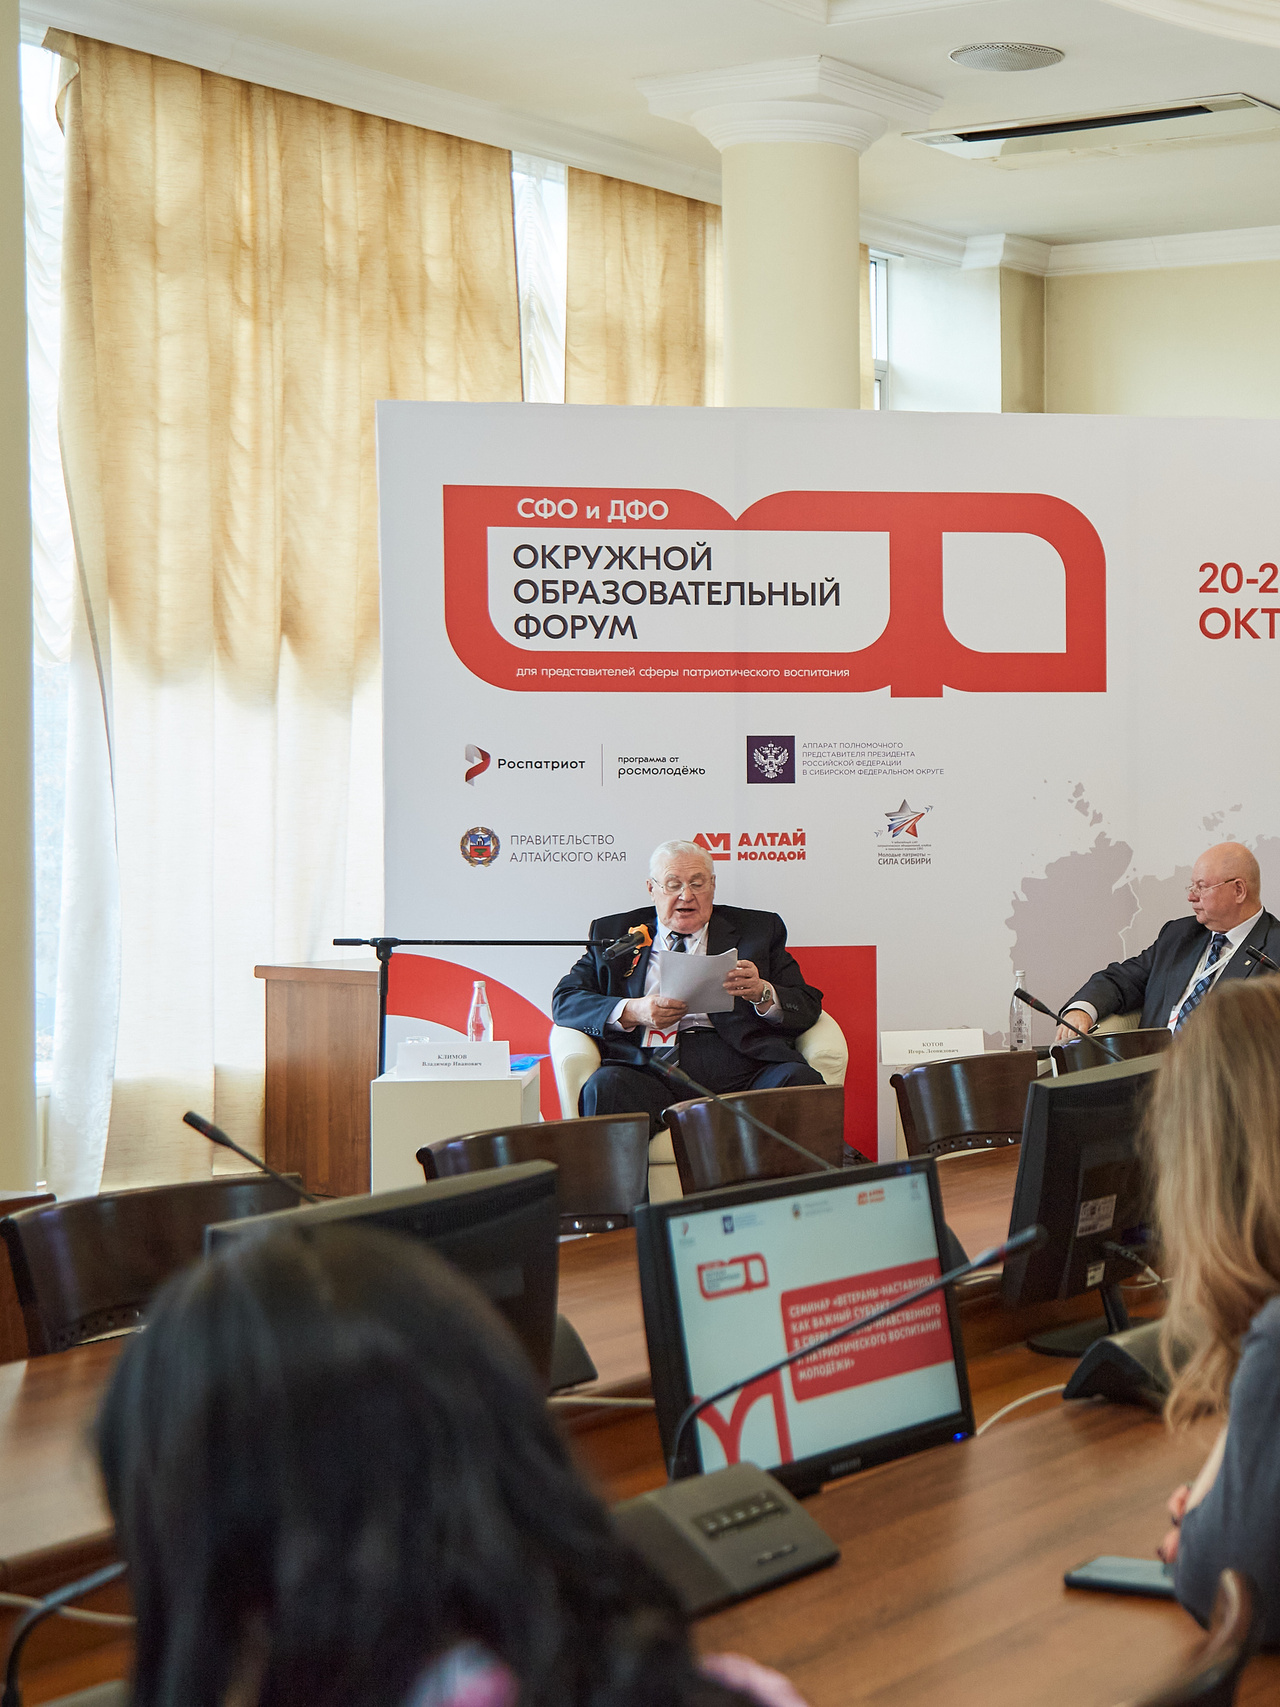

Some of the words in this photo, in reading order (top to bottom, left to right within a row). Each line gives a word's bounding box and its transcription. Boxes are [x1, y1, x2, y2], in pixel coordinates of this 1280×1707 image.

[517, 498, 578, 519] СФО
[586, 505, 600, 519] и
[608, 500, 669, 521] ДФО
[513, 541, 713, 570] ОКРУЖНОЙ
[513, 577, 841, 606] ОБРАЗОВАТЕЛЬНЫЙ
[513, 614, 638, 640] ФОРУМ
[516, 667, 538, 677] для
[541, 667, 636, 678] представителей
[639, 667, 680, 679] сферы
[683, 667, 781, 679] патриотического
[784, 668, 850, 679] воспитания
[497, 758, 586, 771] Роспатриот
[618, 755, 667, 764] программа
[802, 759, 855, 767] РОССИЙСКОЙ
[618, 765, 706, 779] росмолодёжь
[857, 768, 915, 776] ФЕДЕРАЛЬНОМ
[510, 834, 615, 846] ПРАВИТЕЛЬСТВО
[738, 828, 806, 846] АЛТАЙ
[510, 849, 594, 862] АЛТАЙСКОГО
[597, 851, 627, 862] КРАЯ
[878, 858, 899, 866] СИЛА
[789, 1298, 831, 1319] СЕМИНАР
[791, 1320, 810, 1334] КАК
[811, 1310, 851, 1329] ВАЖНЫЙ
[889, 1318, 943, 1342] ВОСПИТАНИЯ
